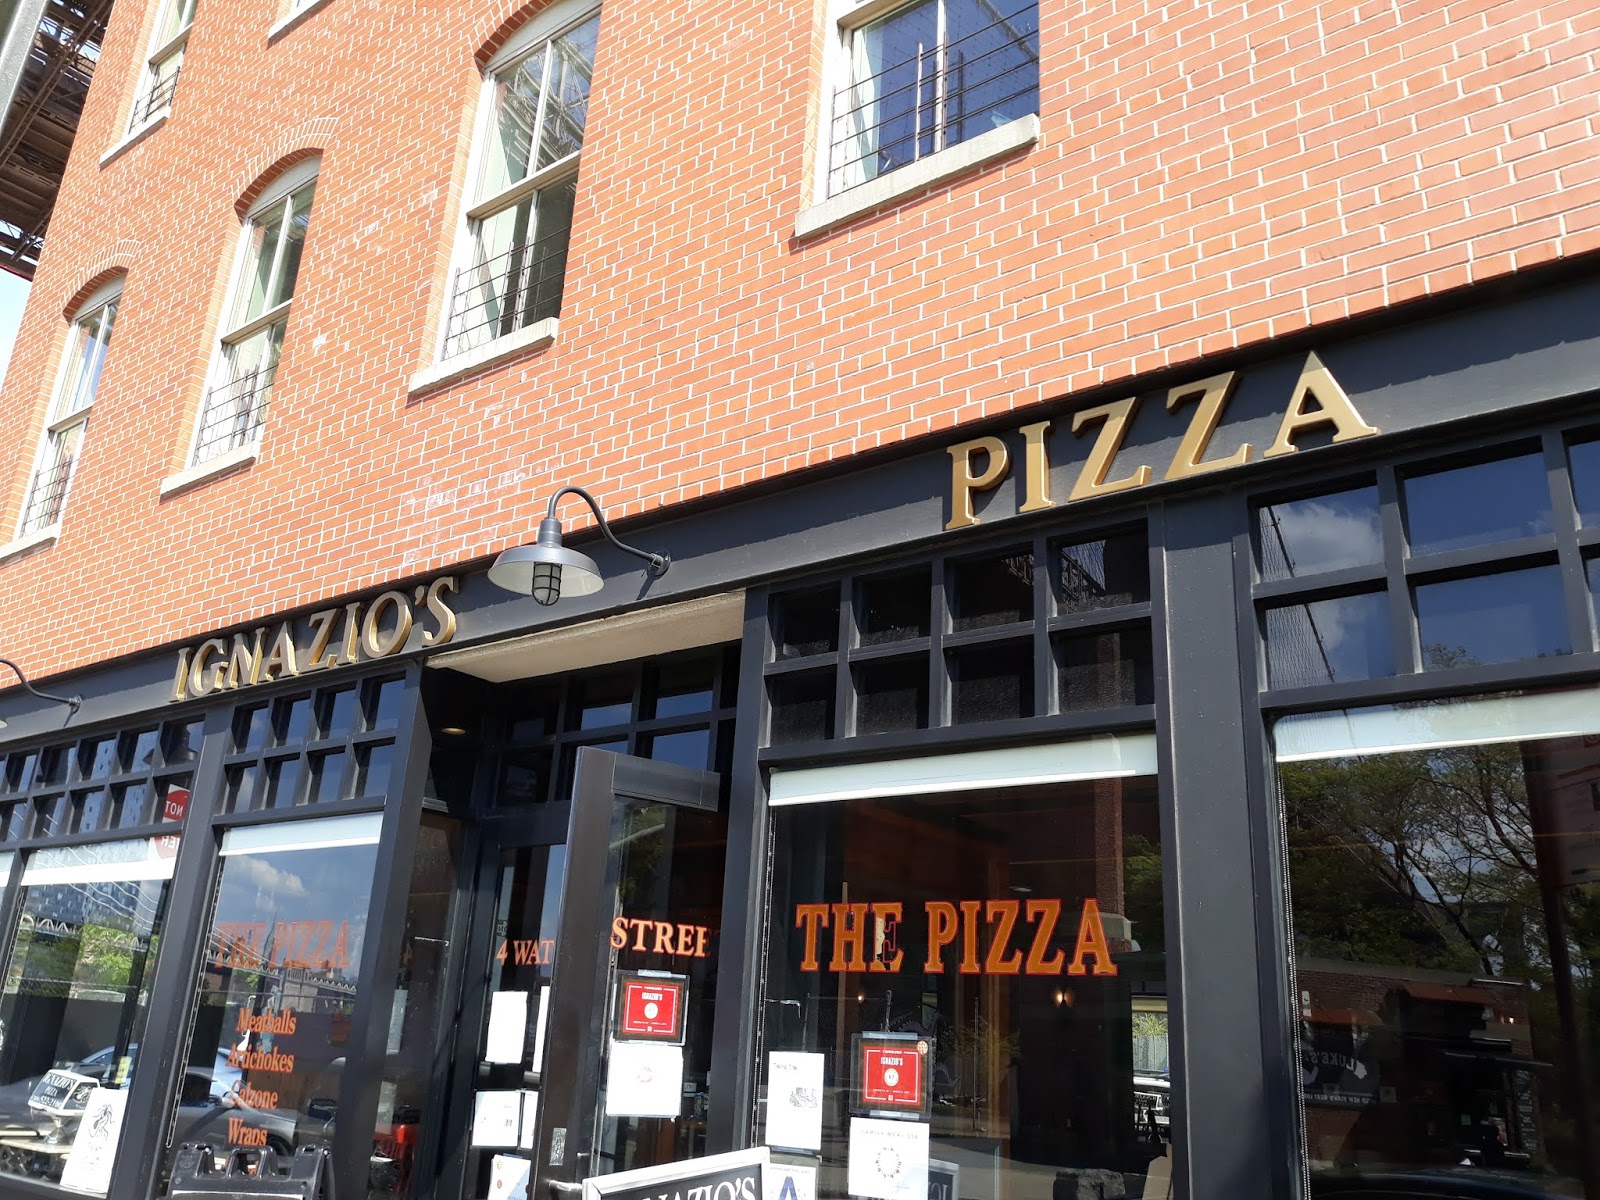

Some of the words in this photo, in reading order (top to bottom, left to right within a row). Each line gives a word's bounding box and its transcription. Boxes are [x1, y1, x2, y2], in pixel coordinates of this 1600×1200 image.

[945, 350, 1381, 530] PIZZA
[172, 576, 459, 701] IGNAZIO'S
[267, 920, 350, 969] PIZZA
[496, 939, 508, 966] 4
[610, 916, 712, 958] STREE
[796, 901, 904, 973] THE
[923, 898, 1118, 976] PIZZA
[236, 1007, 297, 1035] Meatballs
[226, 1043, 295, 1073] Artichokes
[231, 1079, 278, 1110] Calzone
[228, 1117, 267, 1146] Wraps
